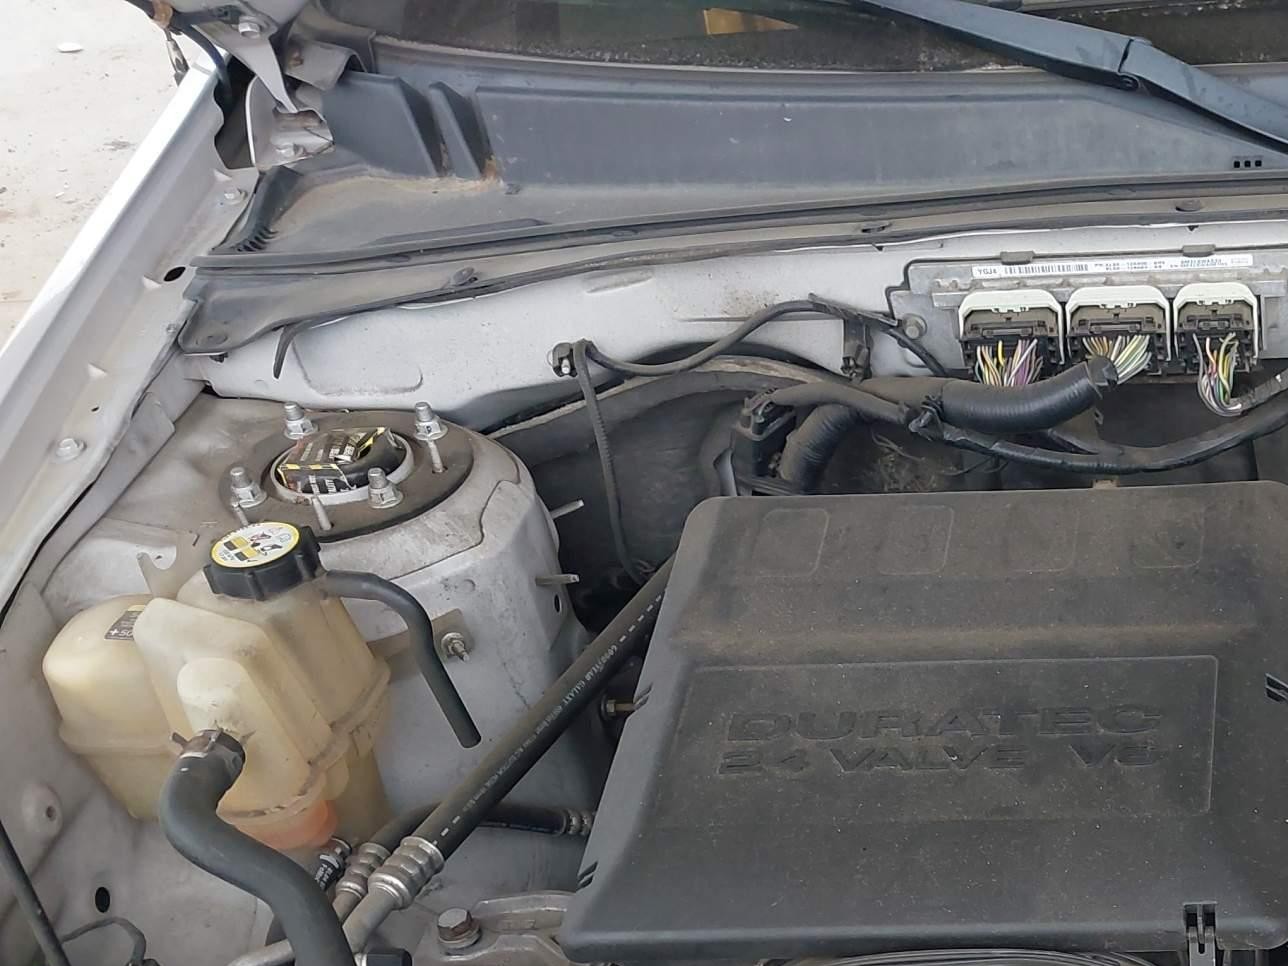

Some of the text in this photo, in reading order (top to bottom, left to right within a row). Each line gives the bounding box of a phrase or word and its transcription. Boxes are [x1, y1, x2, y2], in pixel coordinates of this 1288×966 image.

[728, 704, 1163, 742] DURATEC
[828, 744, 1027, 774] VALVE
[1068, 742, 1168, 770] V6
